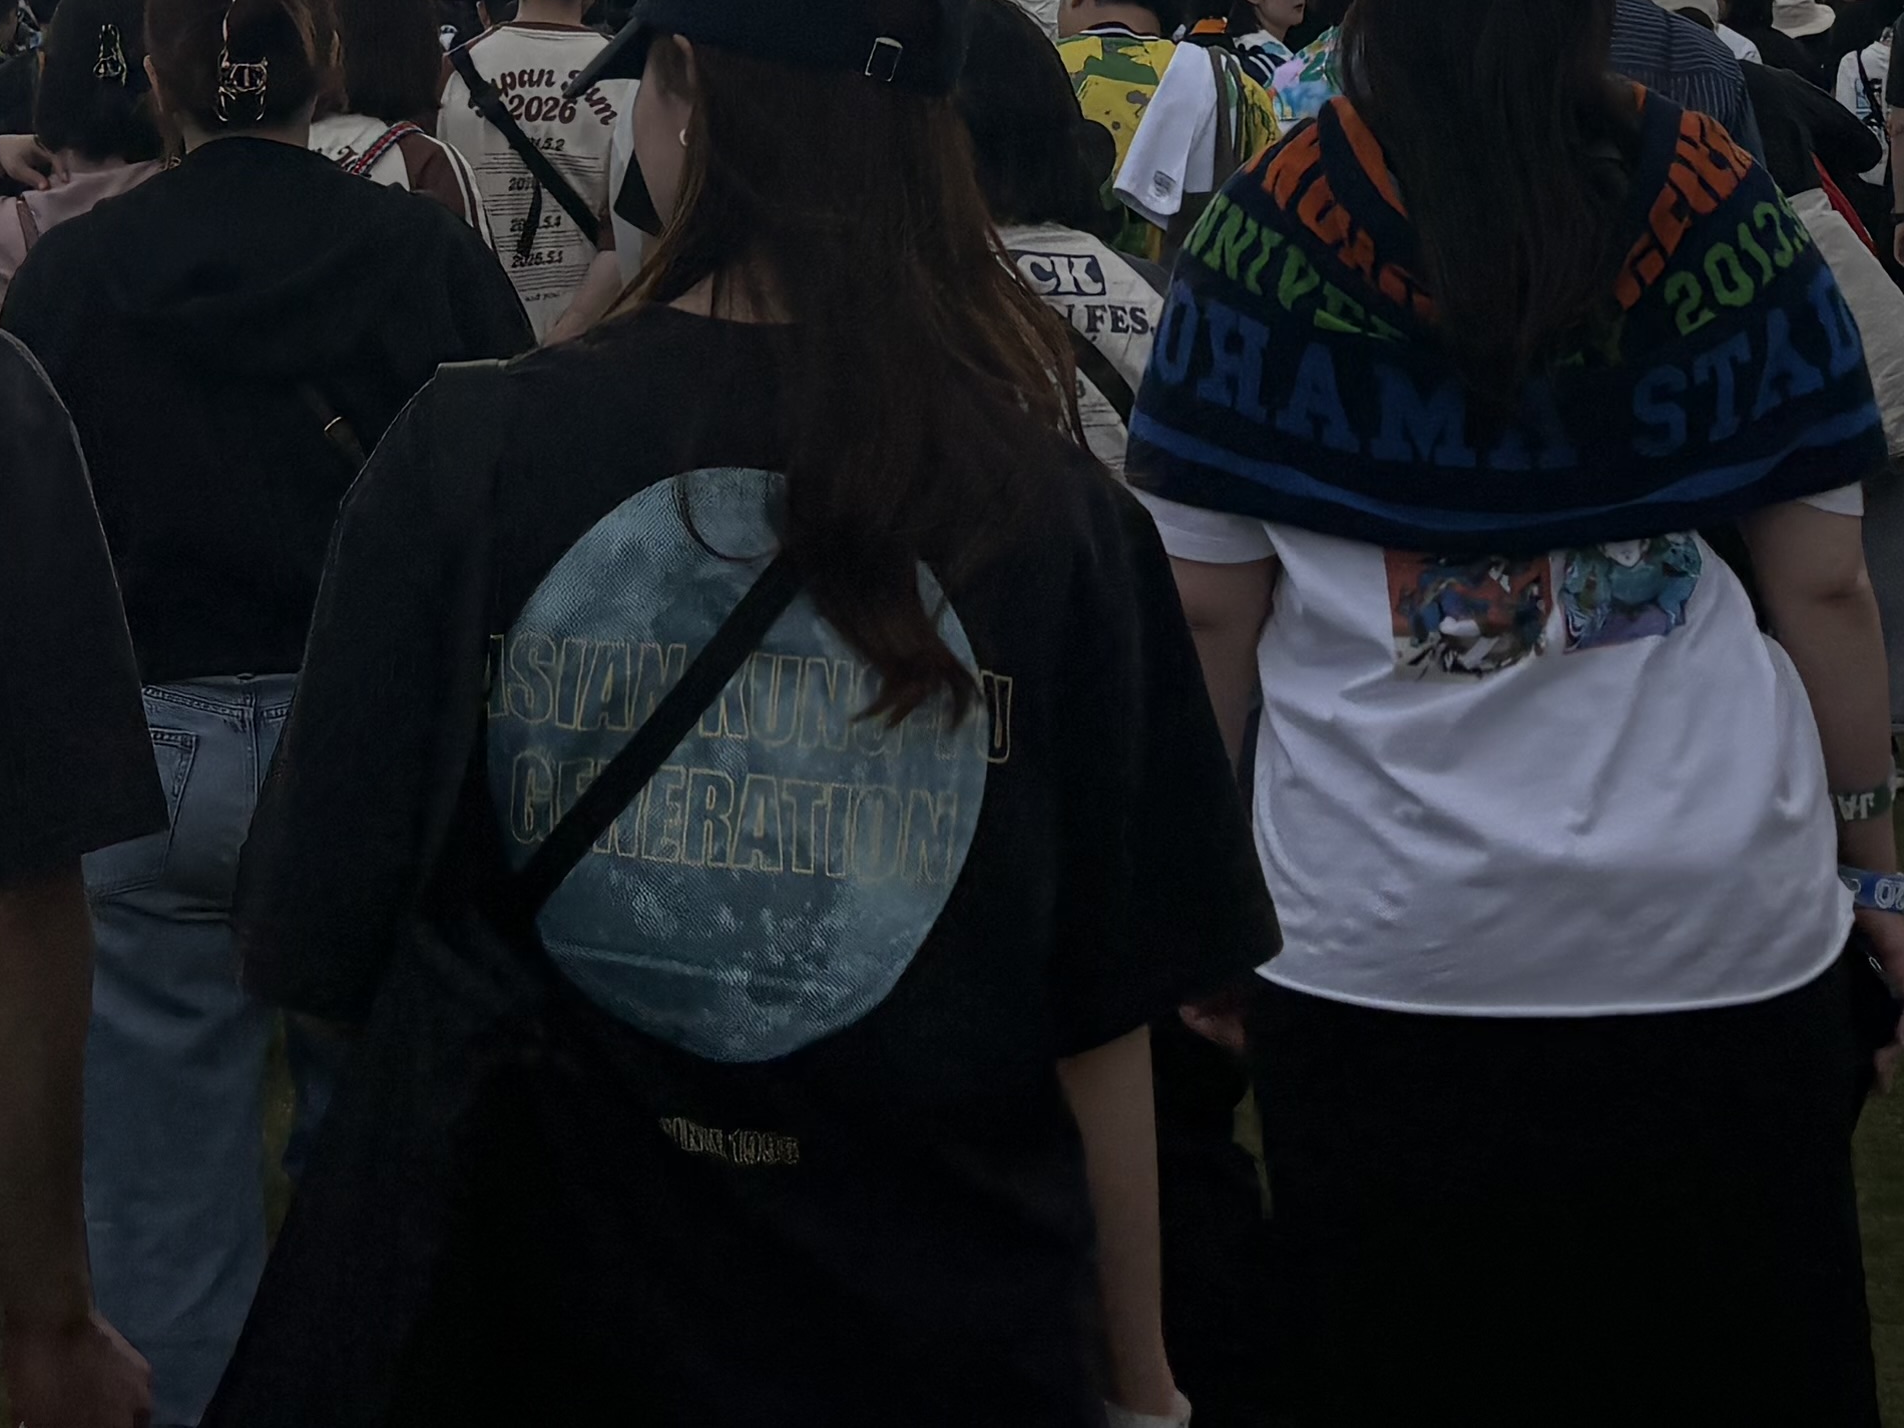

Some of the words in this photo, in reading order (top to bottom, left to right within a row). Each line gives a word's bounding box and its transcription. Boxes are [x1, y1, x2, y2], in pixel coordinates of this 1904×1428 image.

[508, 94, 577, 124] 2026
[1015, 253, 1104, 294] CK
[1085, 304, 1155, 335] FES.
